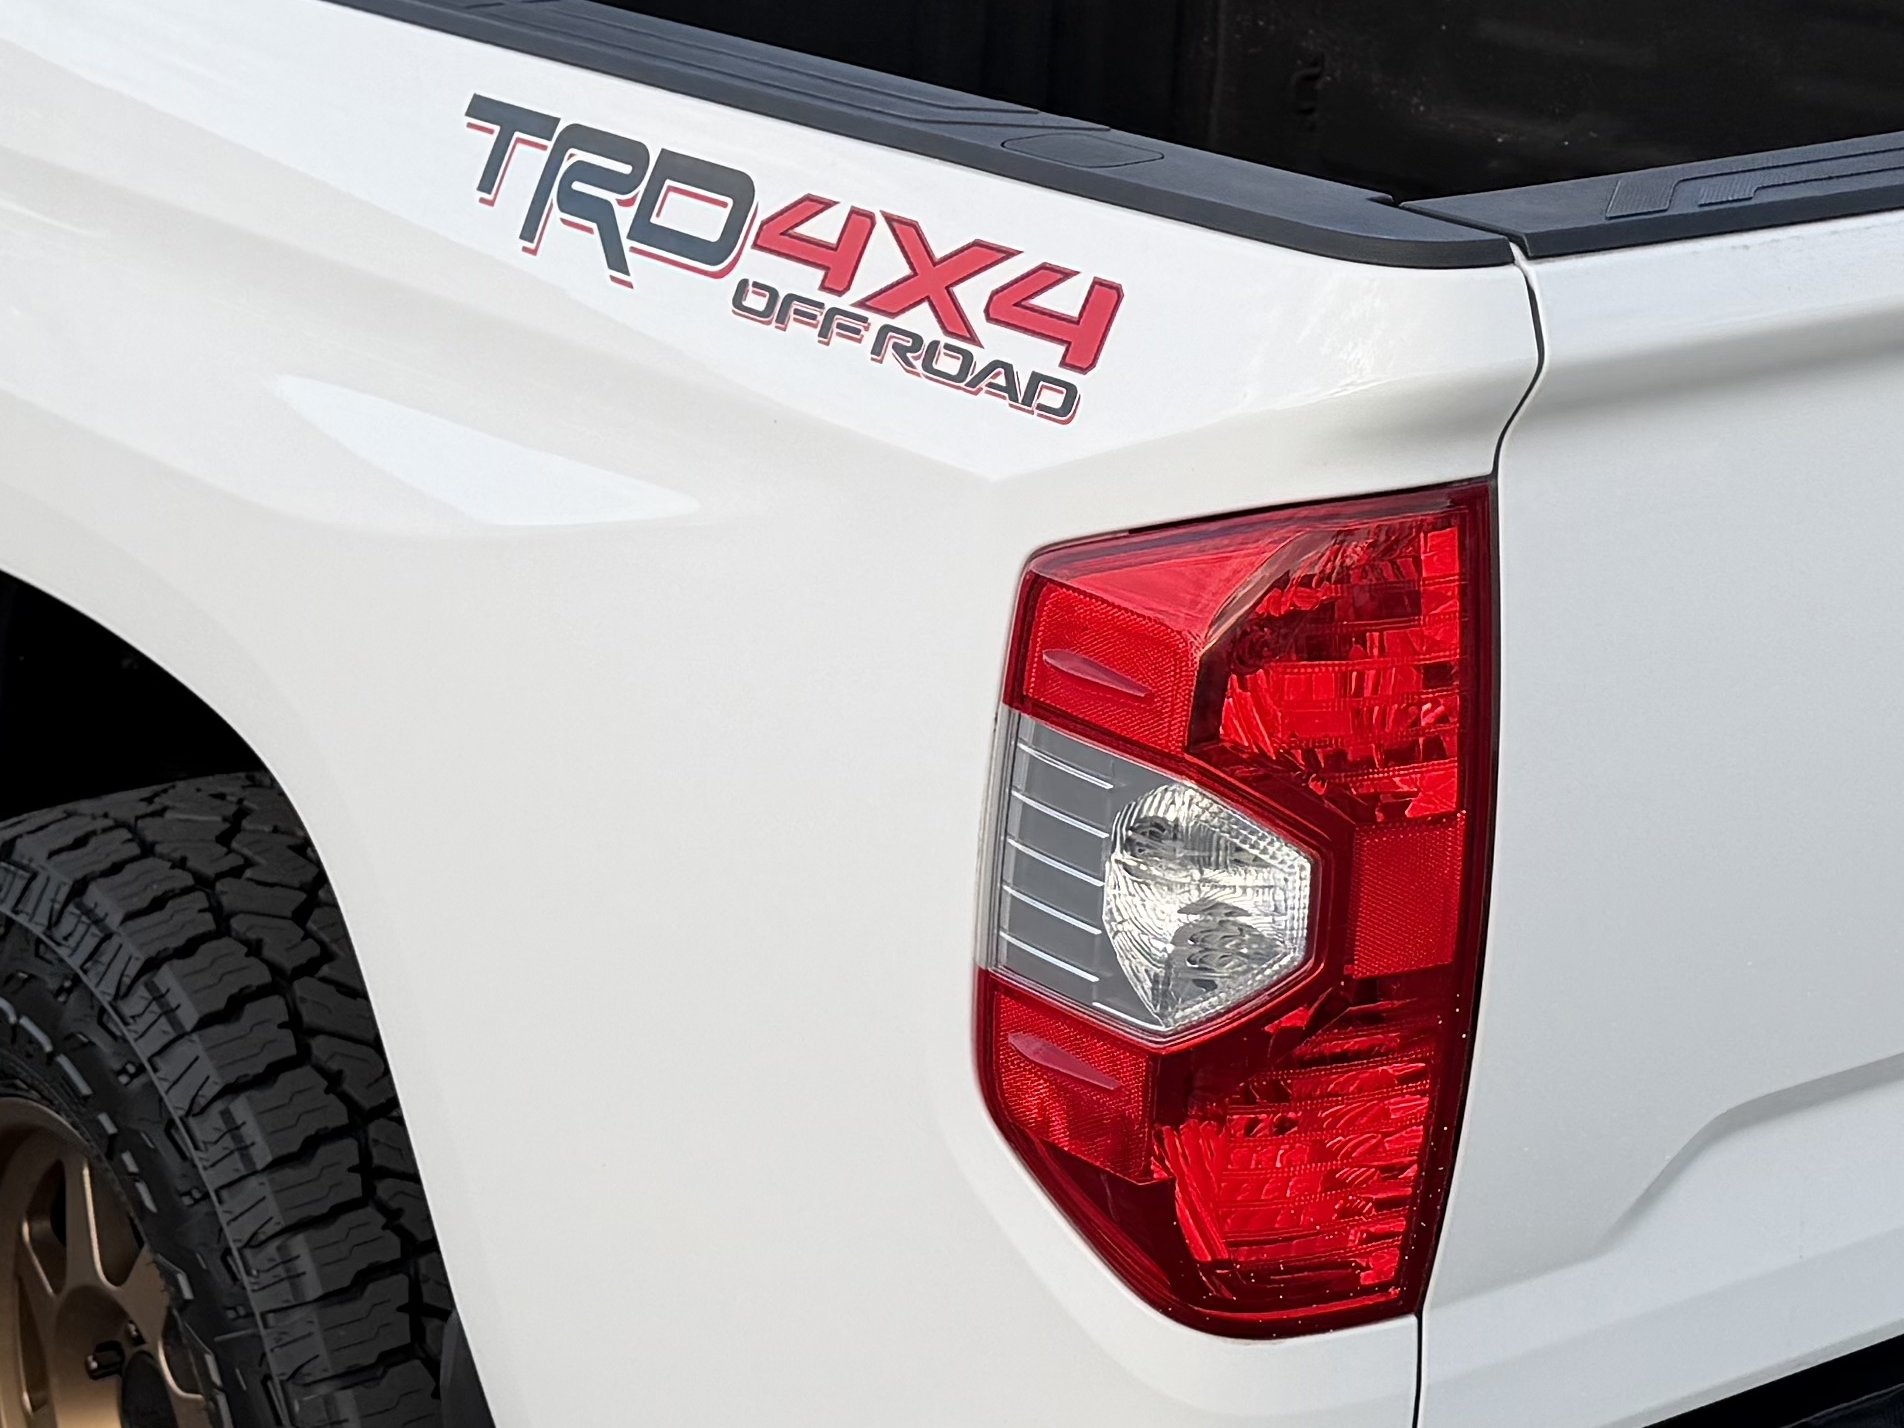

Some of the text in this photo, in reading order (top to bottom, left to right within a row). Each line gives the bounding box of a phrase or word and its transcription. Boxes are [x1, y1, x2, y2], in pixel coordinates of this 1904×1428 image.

[464, 93, 1124, 375] TRD 4X4
[731, 278, 1081, 425] OFF ROAD
